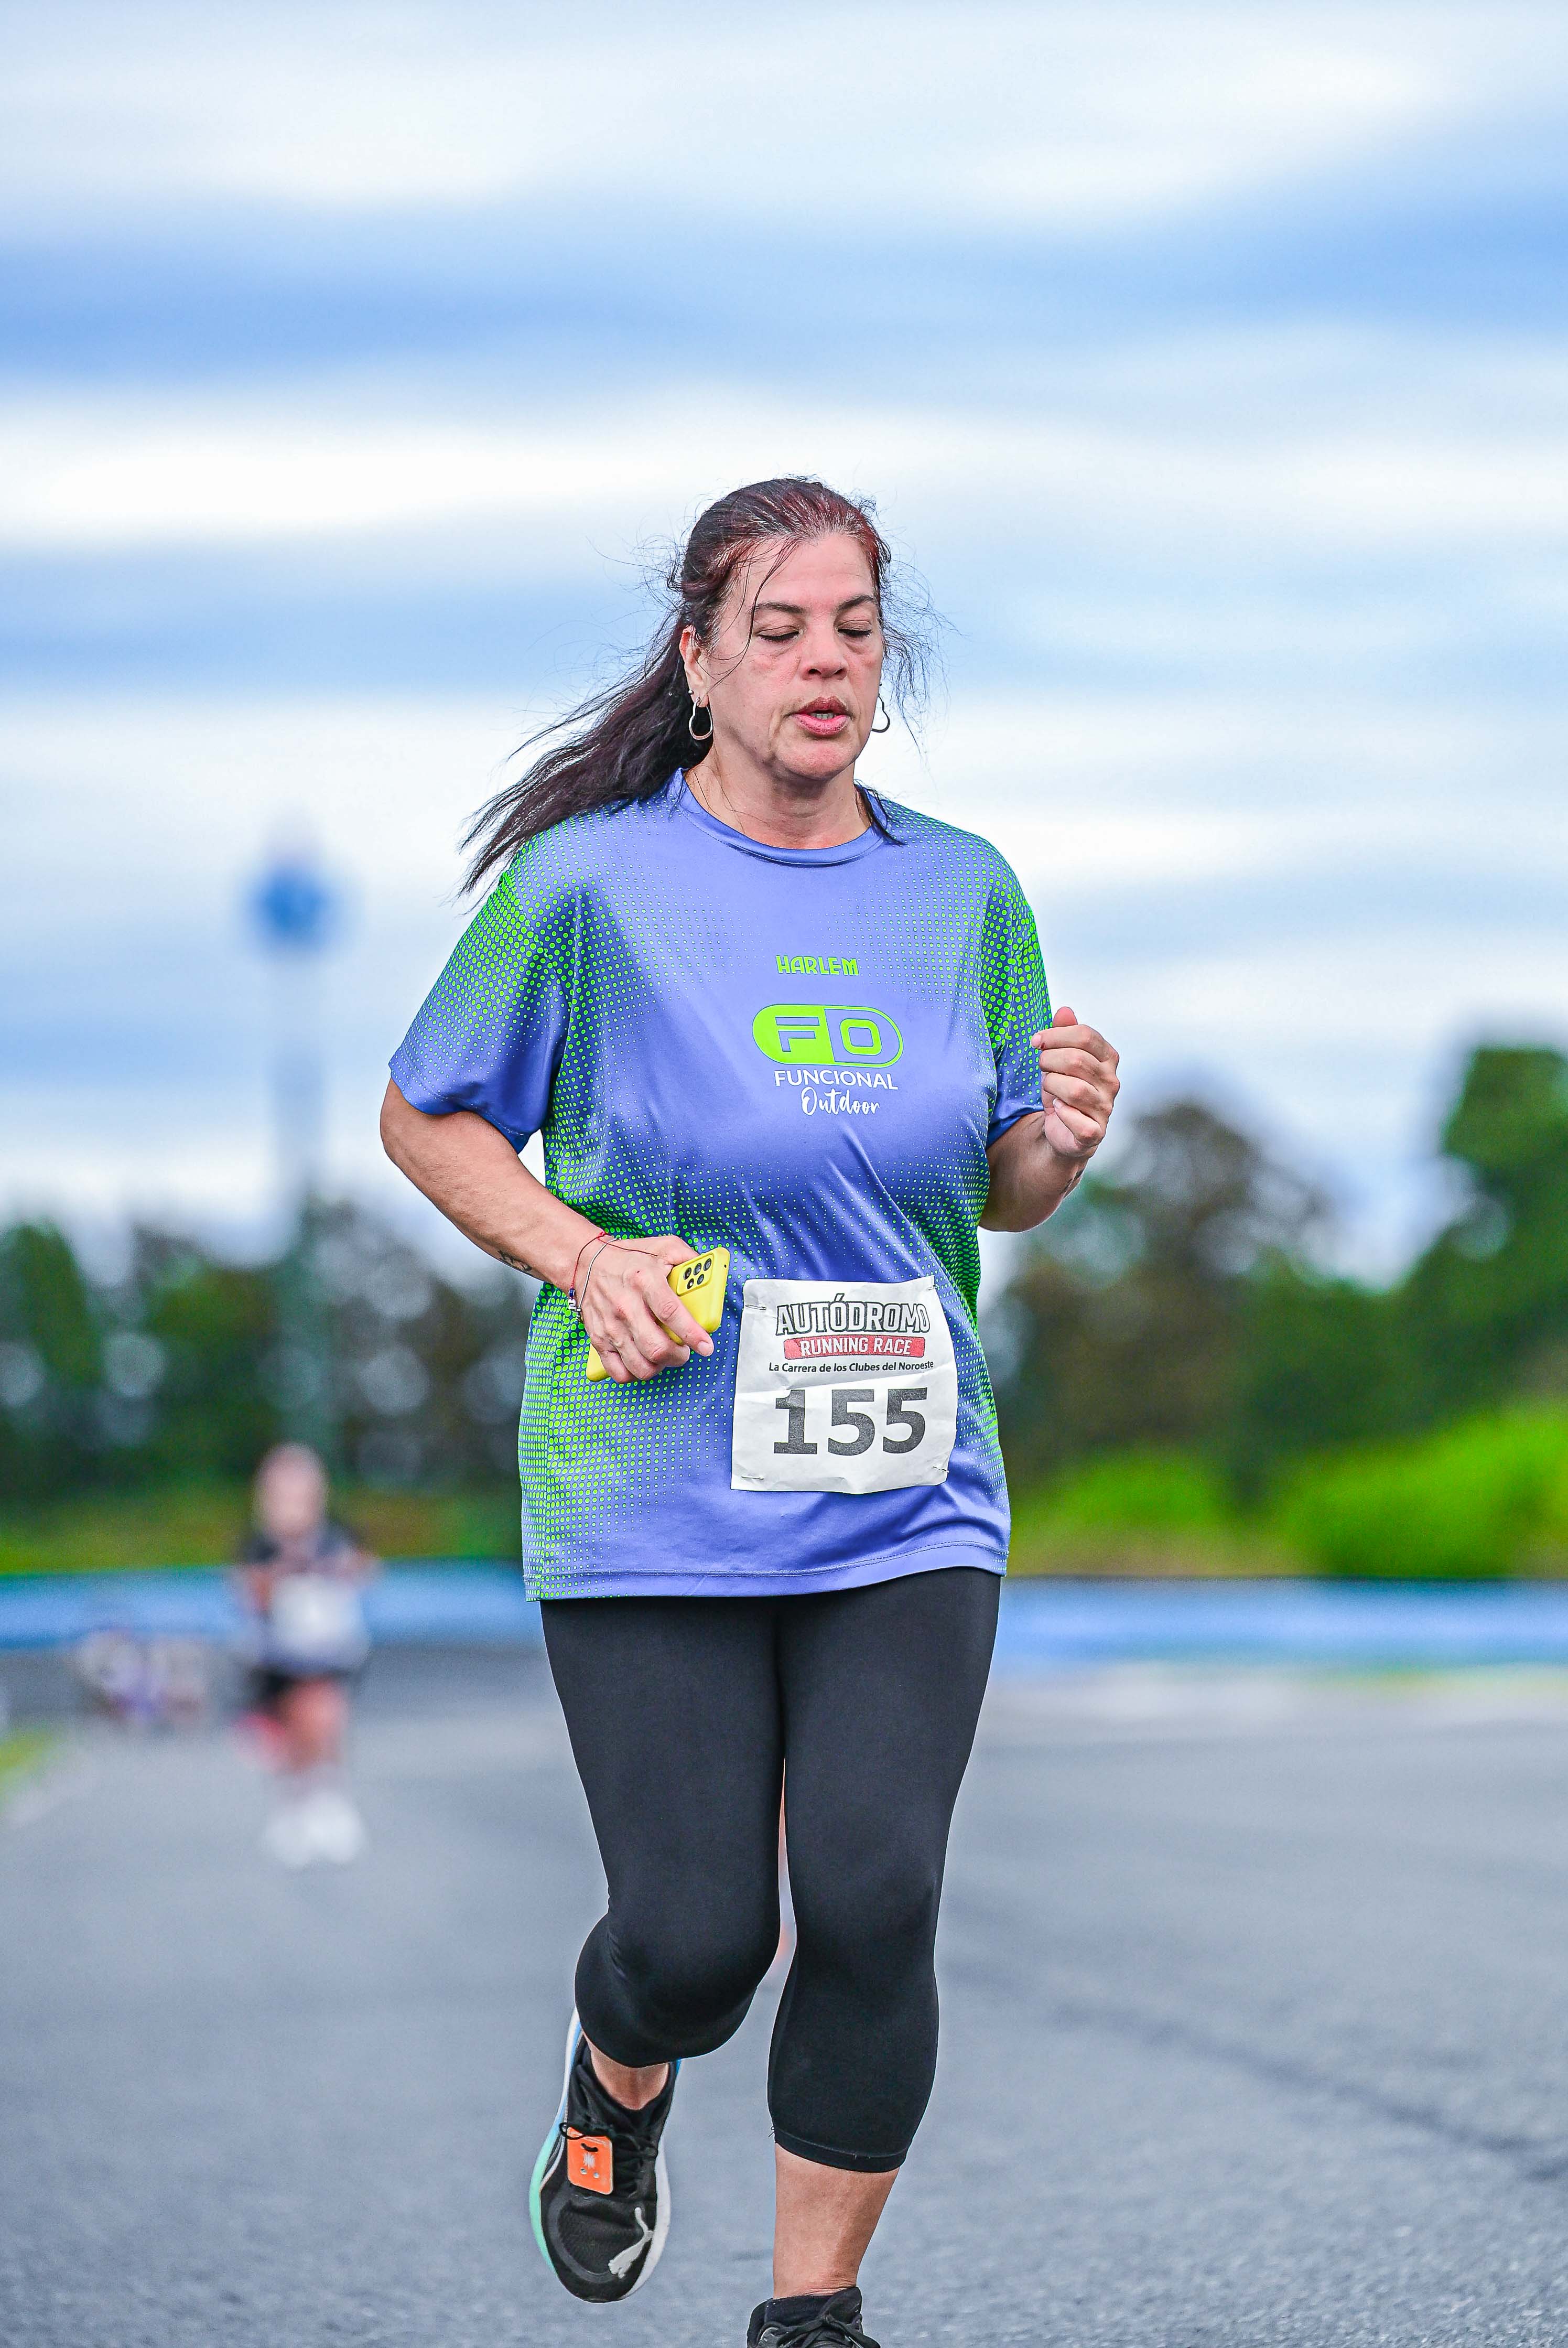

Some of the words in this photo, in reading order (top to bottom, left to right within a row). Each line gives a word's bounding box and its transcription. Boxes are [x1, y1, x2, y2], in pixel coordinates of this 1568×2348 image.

[776, 955, 859, 976] HARLEM
[774, 1069, 898, 1090] FUNCIONAL
[801, 1086, 880, 1115] Outdoor
[776, 1293, 930, 1335] AUTÓDROMO
[801, 1337, 868, 1356] RUNNING
[873, 1338, 912, 1355] RACE
[769, 1362, 779, 1371] La
[782, 1363, 817, 1372] Carrera
[819, 1363, 831, 1372] de
[834, 1363, 847, 1372] los
[849, 1362, 880, 1372] Clubes
[882, 1362, 896, 1371] del
[899, 1361, 934, 1370] Noroeste
[774, 1387, 927, 1456] 155
